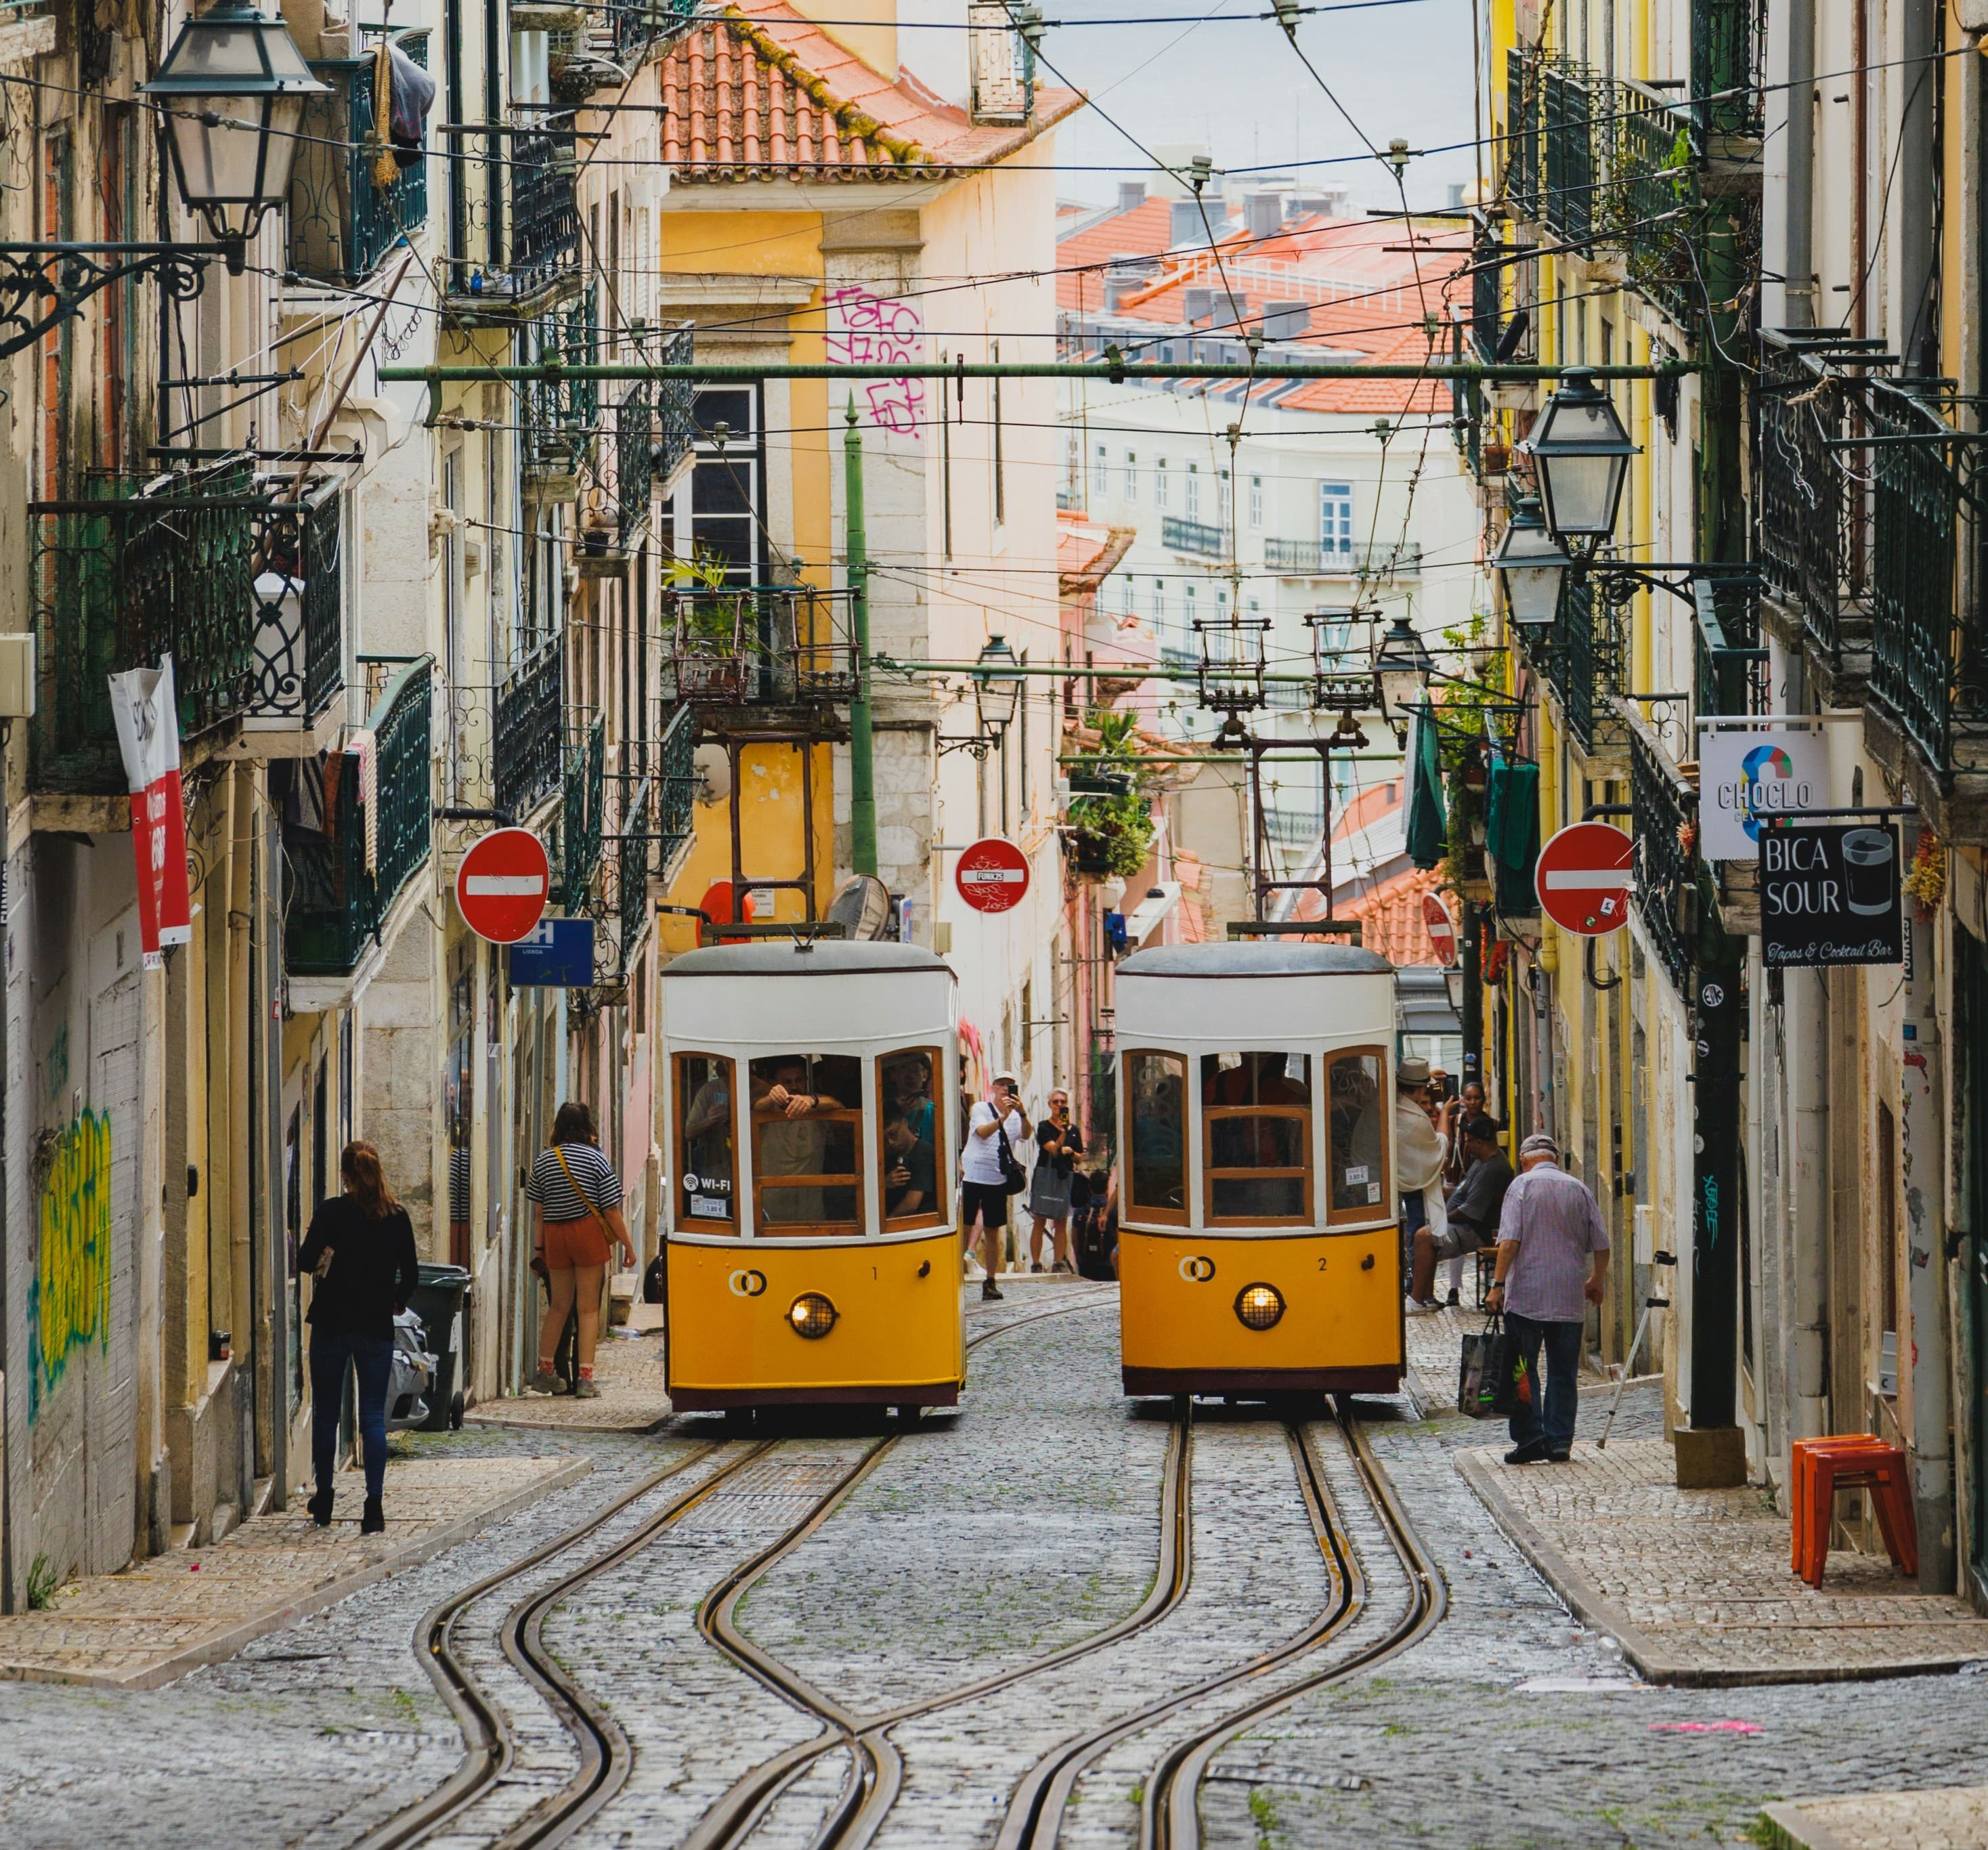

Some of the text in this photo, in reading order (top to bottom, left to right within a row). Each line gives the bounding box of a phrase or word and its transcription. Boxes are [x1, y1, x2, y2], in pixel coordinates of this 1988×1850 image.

[1718, 781, 1813, 809] CHOCLO
[1766, 837, 1829, 872] BICA
[1767, 880, 1840, 915] SOUR
[1767, 939, 1893, 962] Tapas & Cocktail Bar
[701, 1178, 731, 1191] WI-FI
[872, 1266, 877, 1281] 1
[1318, 1257, 1327, 1271] 2
